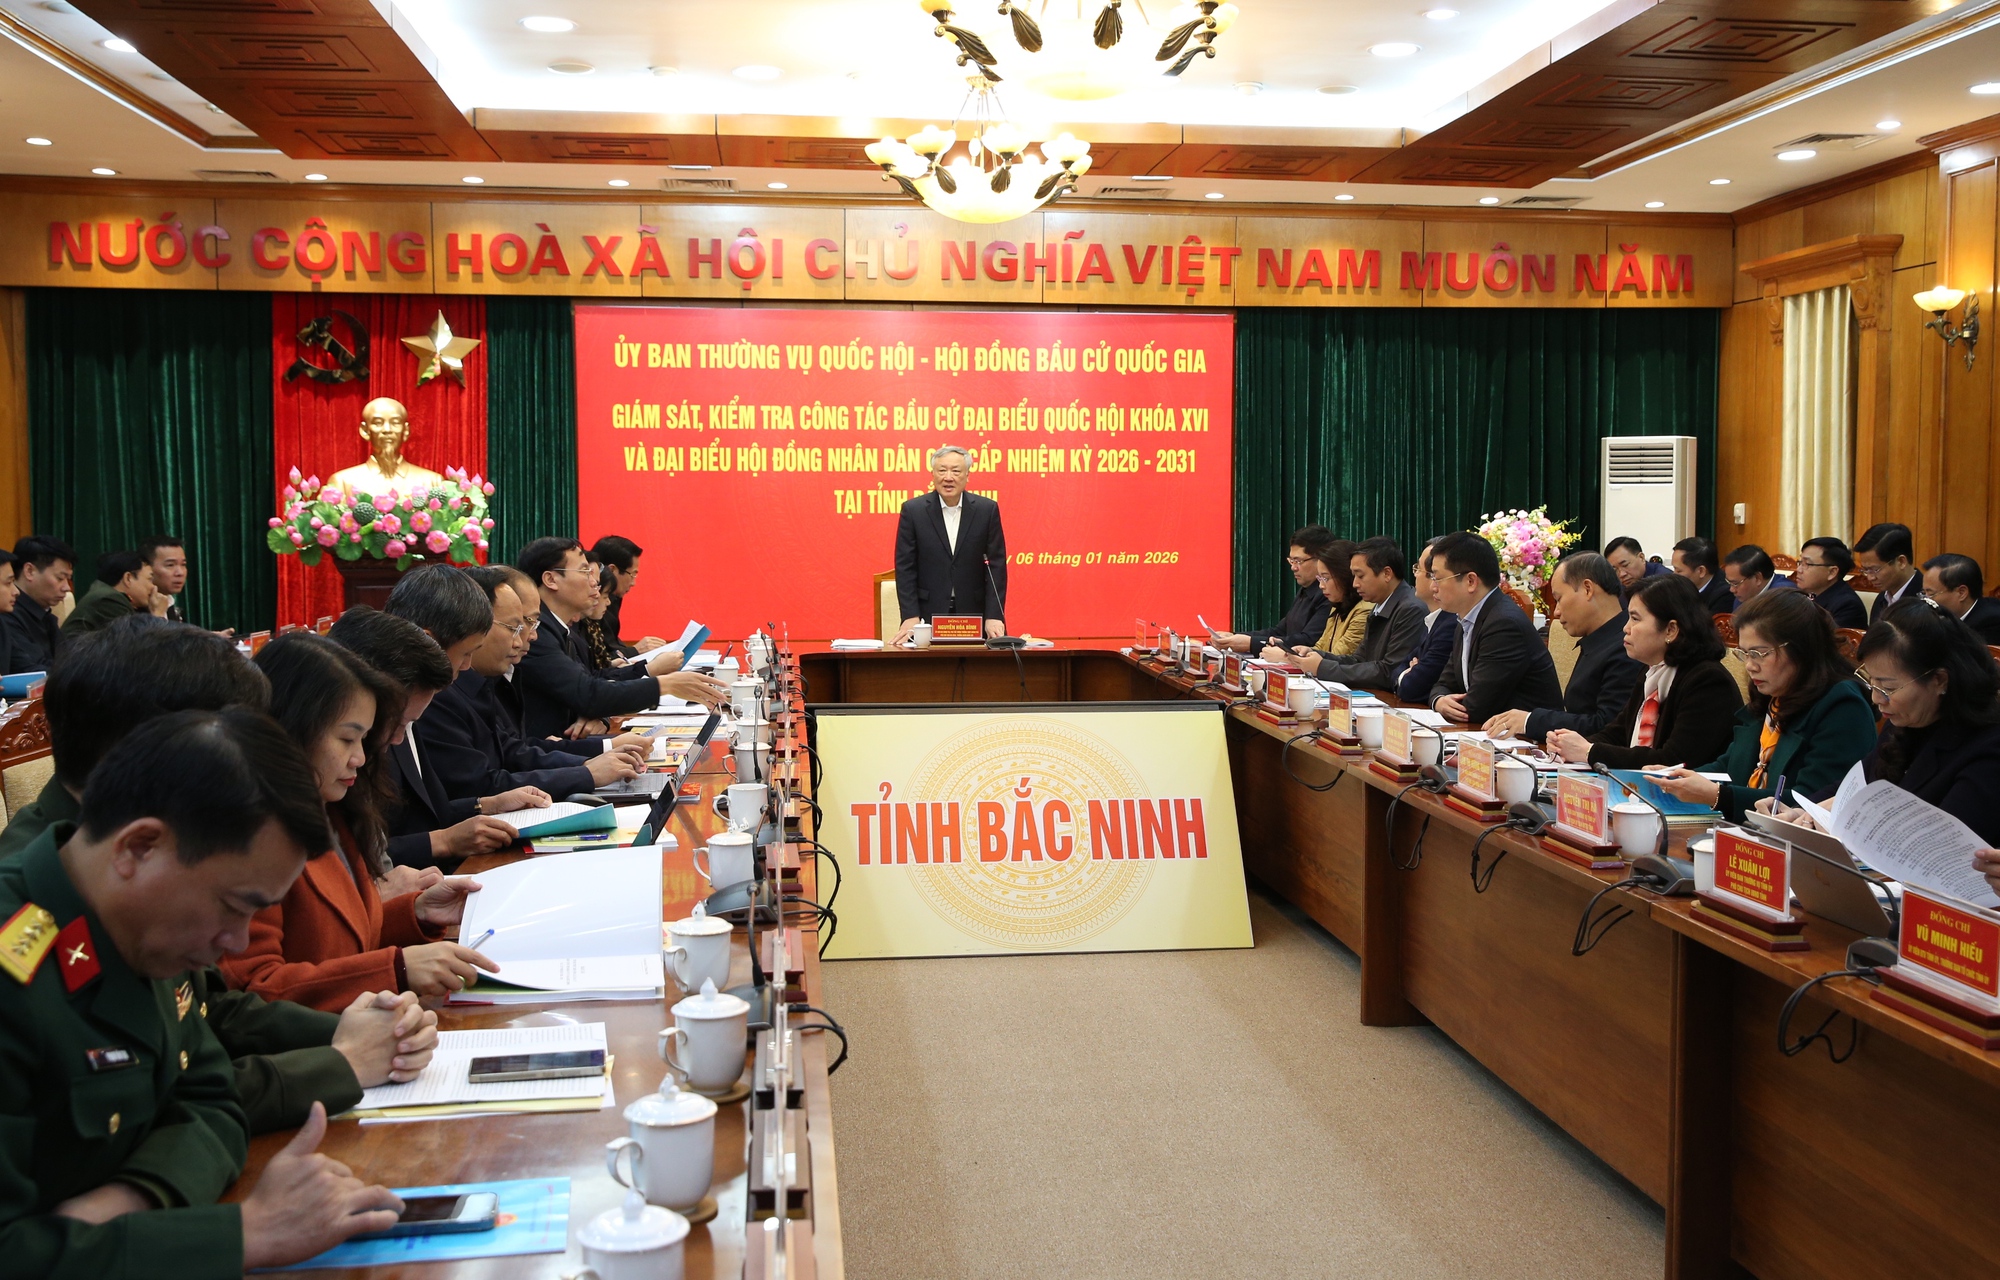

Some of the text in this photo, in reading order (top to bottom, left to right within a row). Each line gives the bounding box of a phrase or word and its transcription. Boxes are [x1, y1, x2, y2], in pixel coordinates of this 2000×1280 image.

[50, 212, 1693, 296] NƯỚC CỘNG HOÀ XÃ HỘI CHỦ NGHĨA VIỆT NAM MUÔN NĂM
[614, 334, 641, 368] ỦY
[647, 343, 692, 369] BAN
[697, 338, 781, 370] THƯỜNG
[786, 345, 813, 375] VỤ
[819, 337, 874, 373] QUỐC
[880, 341, 914, 376] HỘI
[934, 342, 969, 376] HỘI
[974, 339, 1030, 372] ĐỒNG
[1036, 340, 1077, 373] BẦU
[1082, 340, 1112, 373] CỬ
[1115, 340, 1168, 375] QUỐC
[1173, 349, 1207, 374] GIA
[612, 395, 1209, 436] GIÁM SÁT, KIỂM TRA CÔNG TÁC BẦU CỬ ĐẠI BIỂU QUỐC HỘI KHÓA XVI
[624, 442, 649, 472] VÀ
[653, 446, 685, 477] ĐẠI
[689, 437, 732, 472] BIỂU
[737, 442, 768, 477] HỘI
[772, 439, 823, 472] ĐỒNG
[827, 443, 879, 472] NHÂN
[883, 443, 921, 473] DÂN
[968, 440, 1003, 473] CẤP
[1007, 444, 1065, 478] NHIỆM
[1070, 444, 1093, 473] KỲ
[1097, 449, 1140, 473] 2026
[1156, 449, 1196, 473] 2031
[833, 489, 863, 519] TẠI
[867, 481, 908, 514] TỈNH
[1015, 552, 1035, 565] 06
[1038, 551, 1082, 568] tháng
[1085, 551, 1103, 565] 01
[1107, 551, 1140, 564] năm
[1143, 551, 1180, 564] 2026
[851, 777, 1208, 865] TỈNH BẮC NINH
[1729, 853, 1771, 882] LÊ XUÂN LỢI
[1735, 842, 1764, 860] ĐỒNG CHÍ
[1930, 910, 1971, 935] ĐỒNG CHÍ
[1916, 923, 1983, 963] VŨ MINH HIẾU
